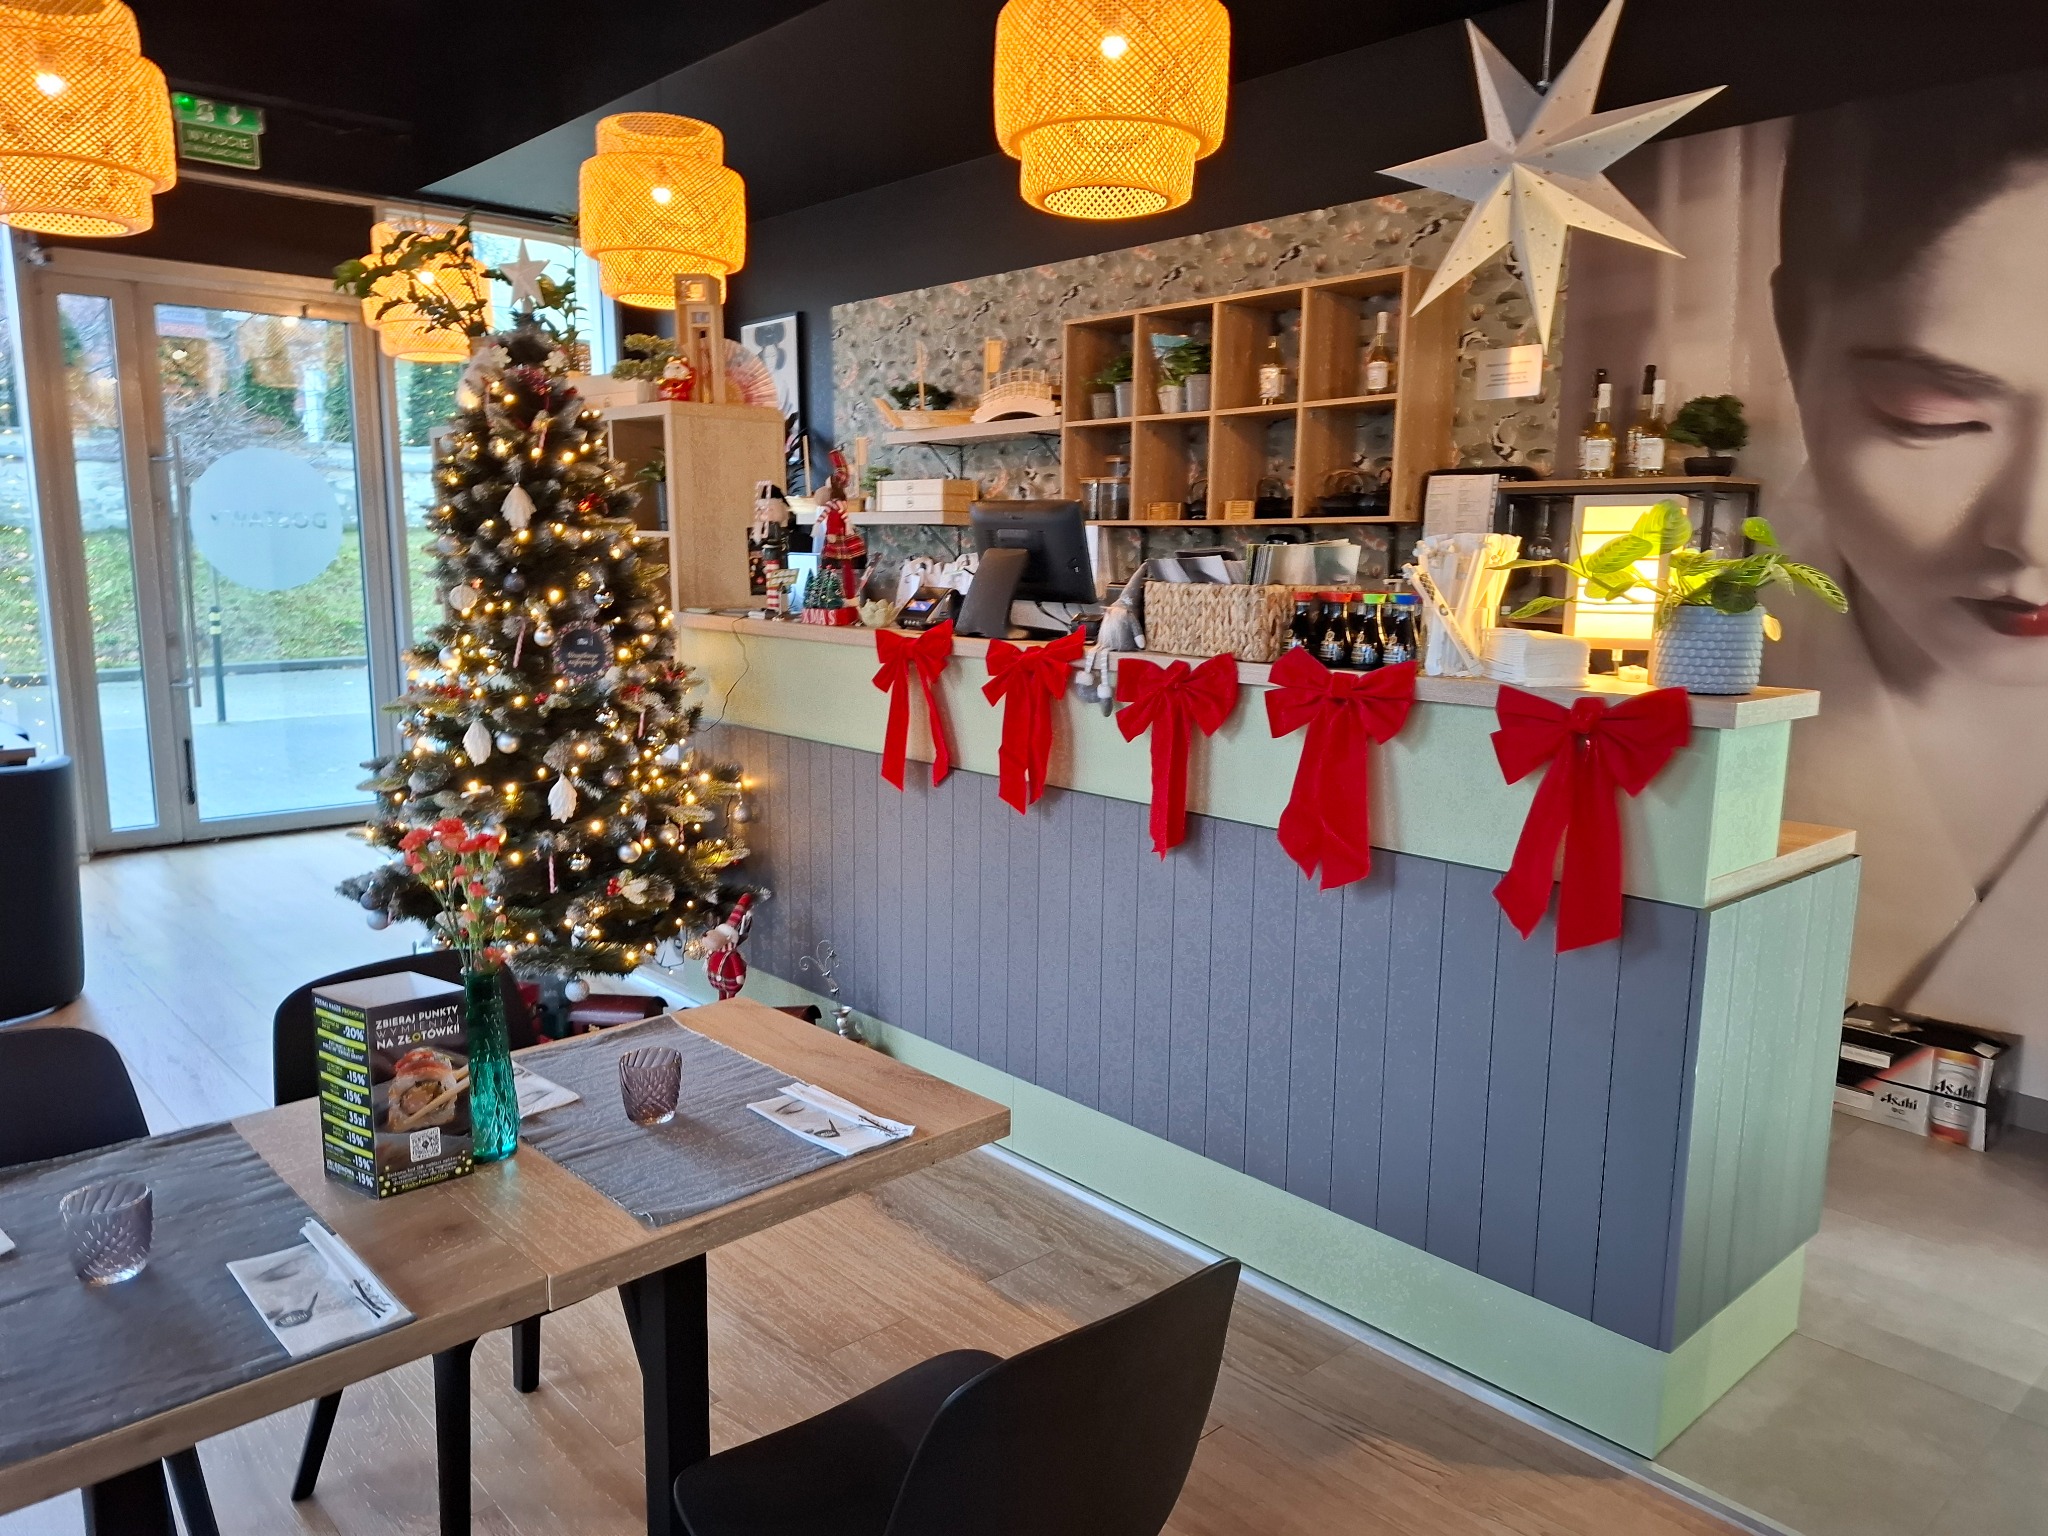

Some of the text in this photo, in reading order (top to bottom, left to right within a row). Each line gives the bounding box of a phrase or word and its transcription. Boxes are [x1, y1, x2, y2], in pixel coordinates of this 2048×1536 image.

[801, 608, 835, 625] XMAS
[376, 1013, 416, 1030] ZBIERAJ
[418, 1005, 459, 1021] PUNKTY
[376, 1014, 460, 1039] WYMIENIAJ
[376, 1037, 394, 1051] NA
[1933, 1078, 1975, 1098] Asahi
[1880, 1093, 1918, 1110] Asahi
